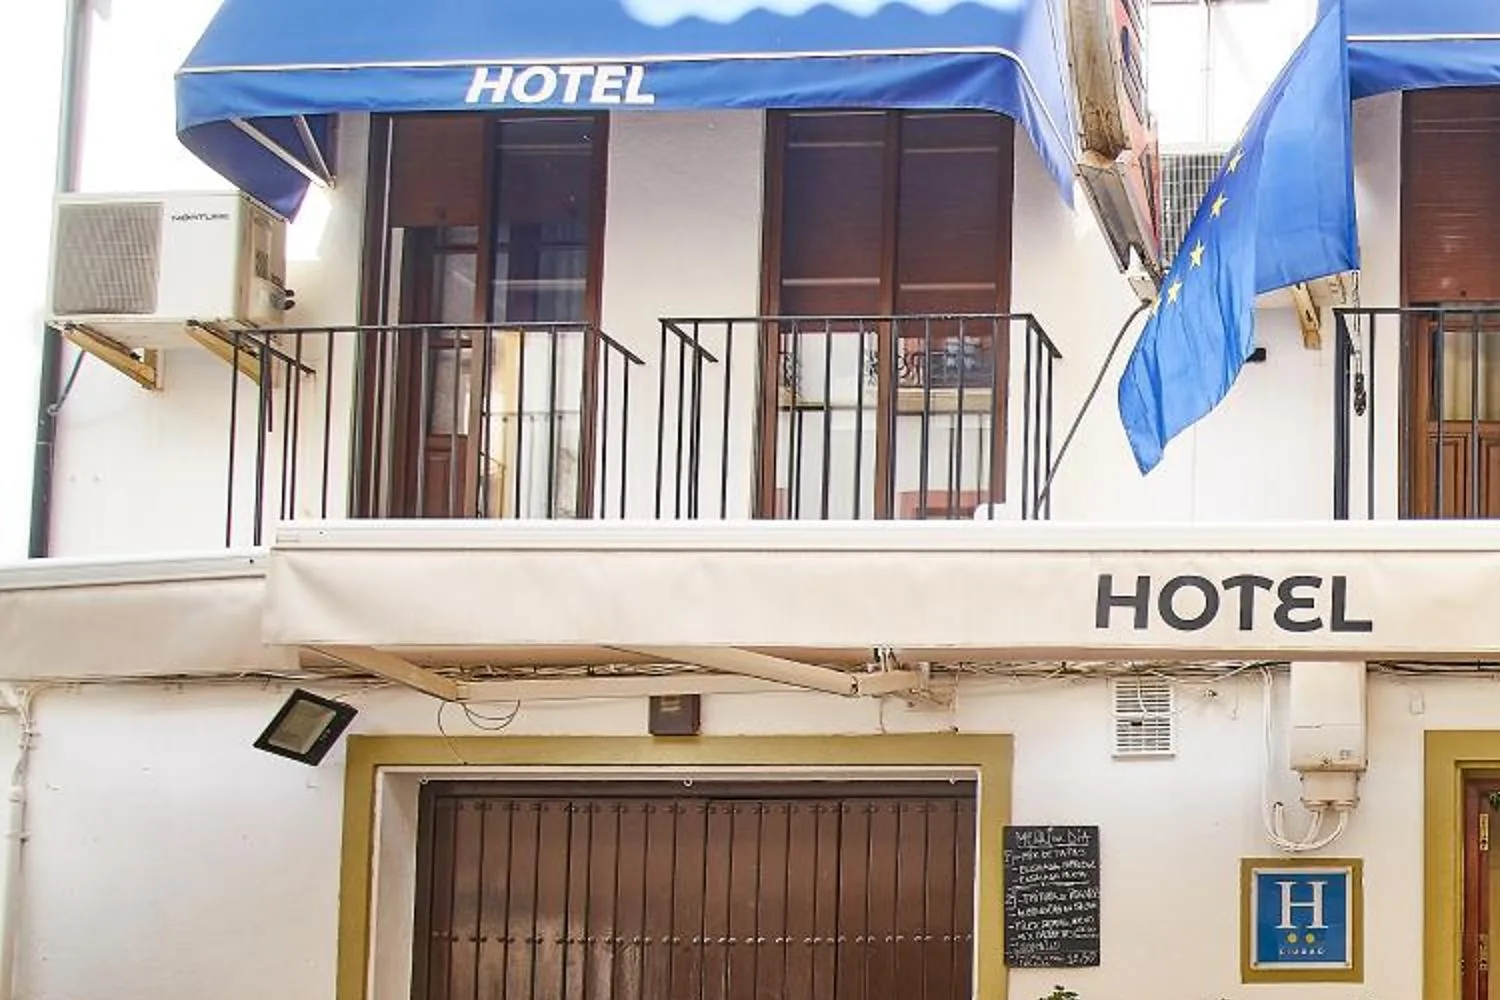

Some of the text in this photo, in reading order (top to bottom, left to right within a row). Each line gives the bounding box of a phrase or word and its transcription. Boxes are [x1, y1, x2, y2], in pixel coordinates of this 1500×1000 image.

[464, 65, 656, 105] HOTEL
[1095, 573, 1374, 633] HOTEL
[1274, 881, 1329, 929] H
